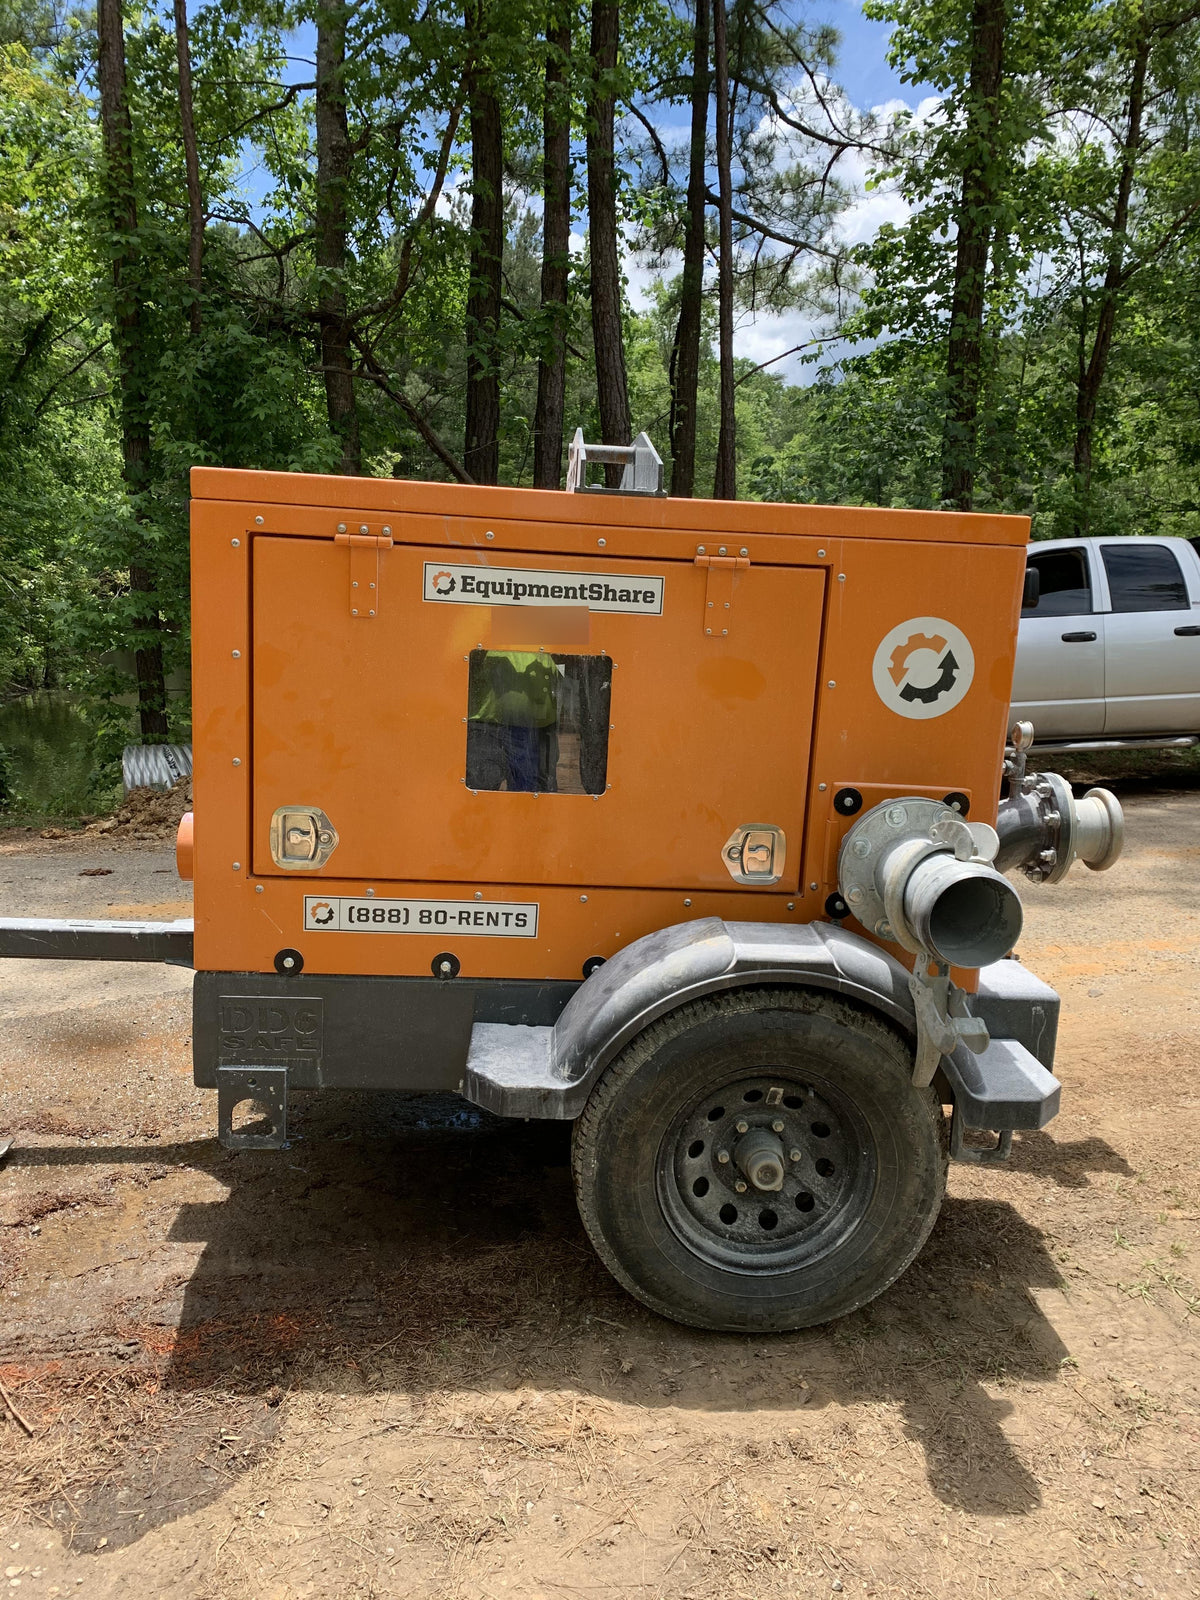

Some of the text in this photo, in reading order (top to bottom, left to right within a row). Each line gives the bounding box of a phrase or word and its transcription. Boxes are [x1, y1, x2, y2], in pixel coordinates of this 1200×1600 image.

[460, 575, 656, 604] EquipmentShare
[348, 905, 528, 928] (888) 80-RENTS
[222, 1036, 319, 1052] SAFE
